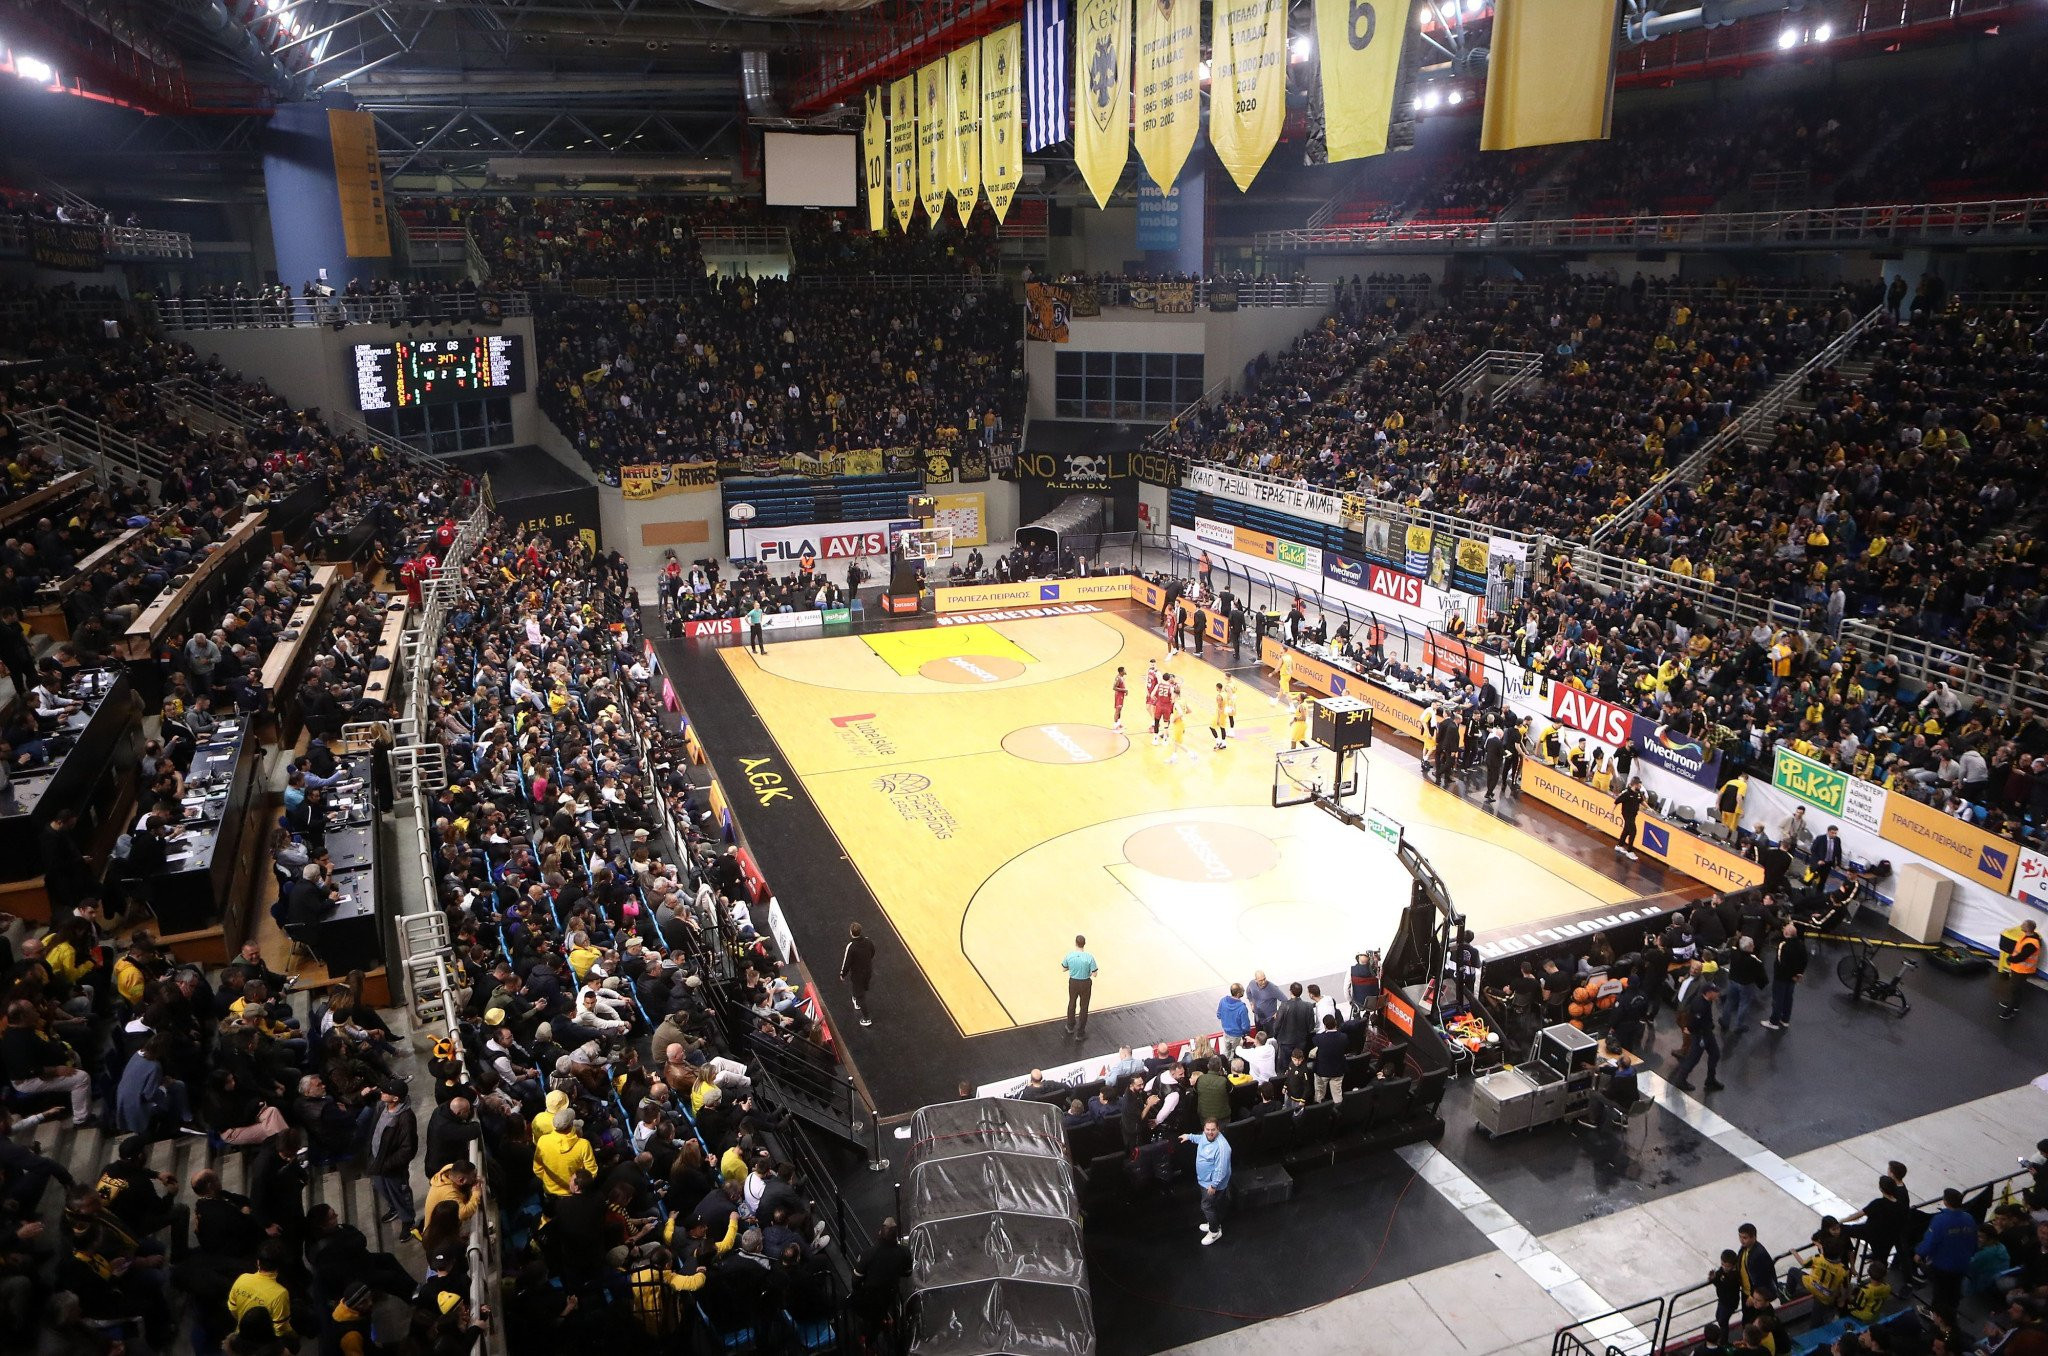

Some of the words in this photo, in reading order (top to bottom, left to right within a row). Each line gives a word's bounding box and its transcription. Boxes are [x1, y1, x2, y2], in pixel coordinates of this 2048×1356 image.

[960, 111, 969, 122] BCL
[1236, 99, 1257, 114] 2020
[870, 156, 880, 190] 10
[1158, 304, 1192, 313] SQUAD
[447, 341, 458, 350] GS
[926, 472, 952, 482] KIPSELI
[1015, 453, 1056, 478] NO
[1108, 452, 1177, 484] LIOSSIA
[1192, 468, 1214, 487] ΚΑΛΟ
[1218, 476, 1248, 495] ΤΑΞΙΔΙ
[1254, 483, 1302, 509] ΤΕΡΑΣΤΙΕ
[555, 514, 575, 526] B.C.
[761, 539, 816, 560] FILA
[827, 534, 882, 558] AVIS
[948, 594, 988, 604] ΤΡΑΠΕΖΑ
[990, 590, 1031, 601] ΠΕΙΡΑΙΩΣ
[1077, 584, 1116, 594] ΤΡΑΠΕΖΑ
[1372, 570, 1418, 604] AVIS
[696, 620, 732, 636] AVIS
[1296, 664, 1324, 683] ΠΕΙΡΑΙΩΣ
[1158, 688, 1169, 697] 22
[1359, 692, 1390, 715] ΤΡΑΠΕΖΑ
[1392, 709, 1423, 730] ΠΕΙΡΑΙΩ
[1556, 688, 1626, 746] AVIS
[1663, 760, 1676, 773] let's
[1676, 764, 1697, 781] colour
[1534, 776, 1578, 809] ΤΡΑΠΕΖΑ
[1581, 800, 1624, 828] ΠΕΙΡΑΙΩ
[1850, 790, 1872, 803] ΑΘΗΝΑ
[905, 794, 952, 840] CHAMPIONS
[1892, 812, 1930, 838] ΤΡΑΠΕΖΑ
[1930, 830, 1974, 859] ΠΕΙΡΑΙΩΣ
[1388, 1001, 1412, 1028] etsson
